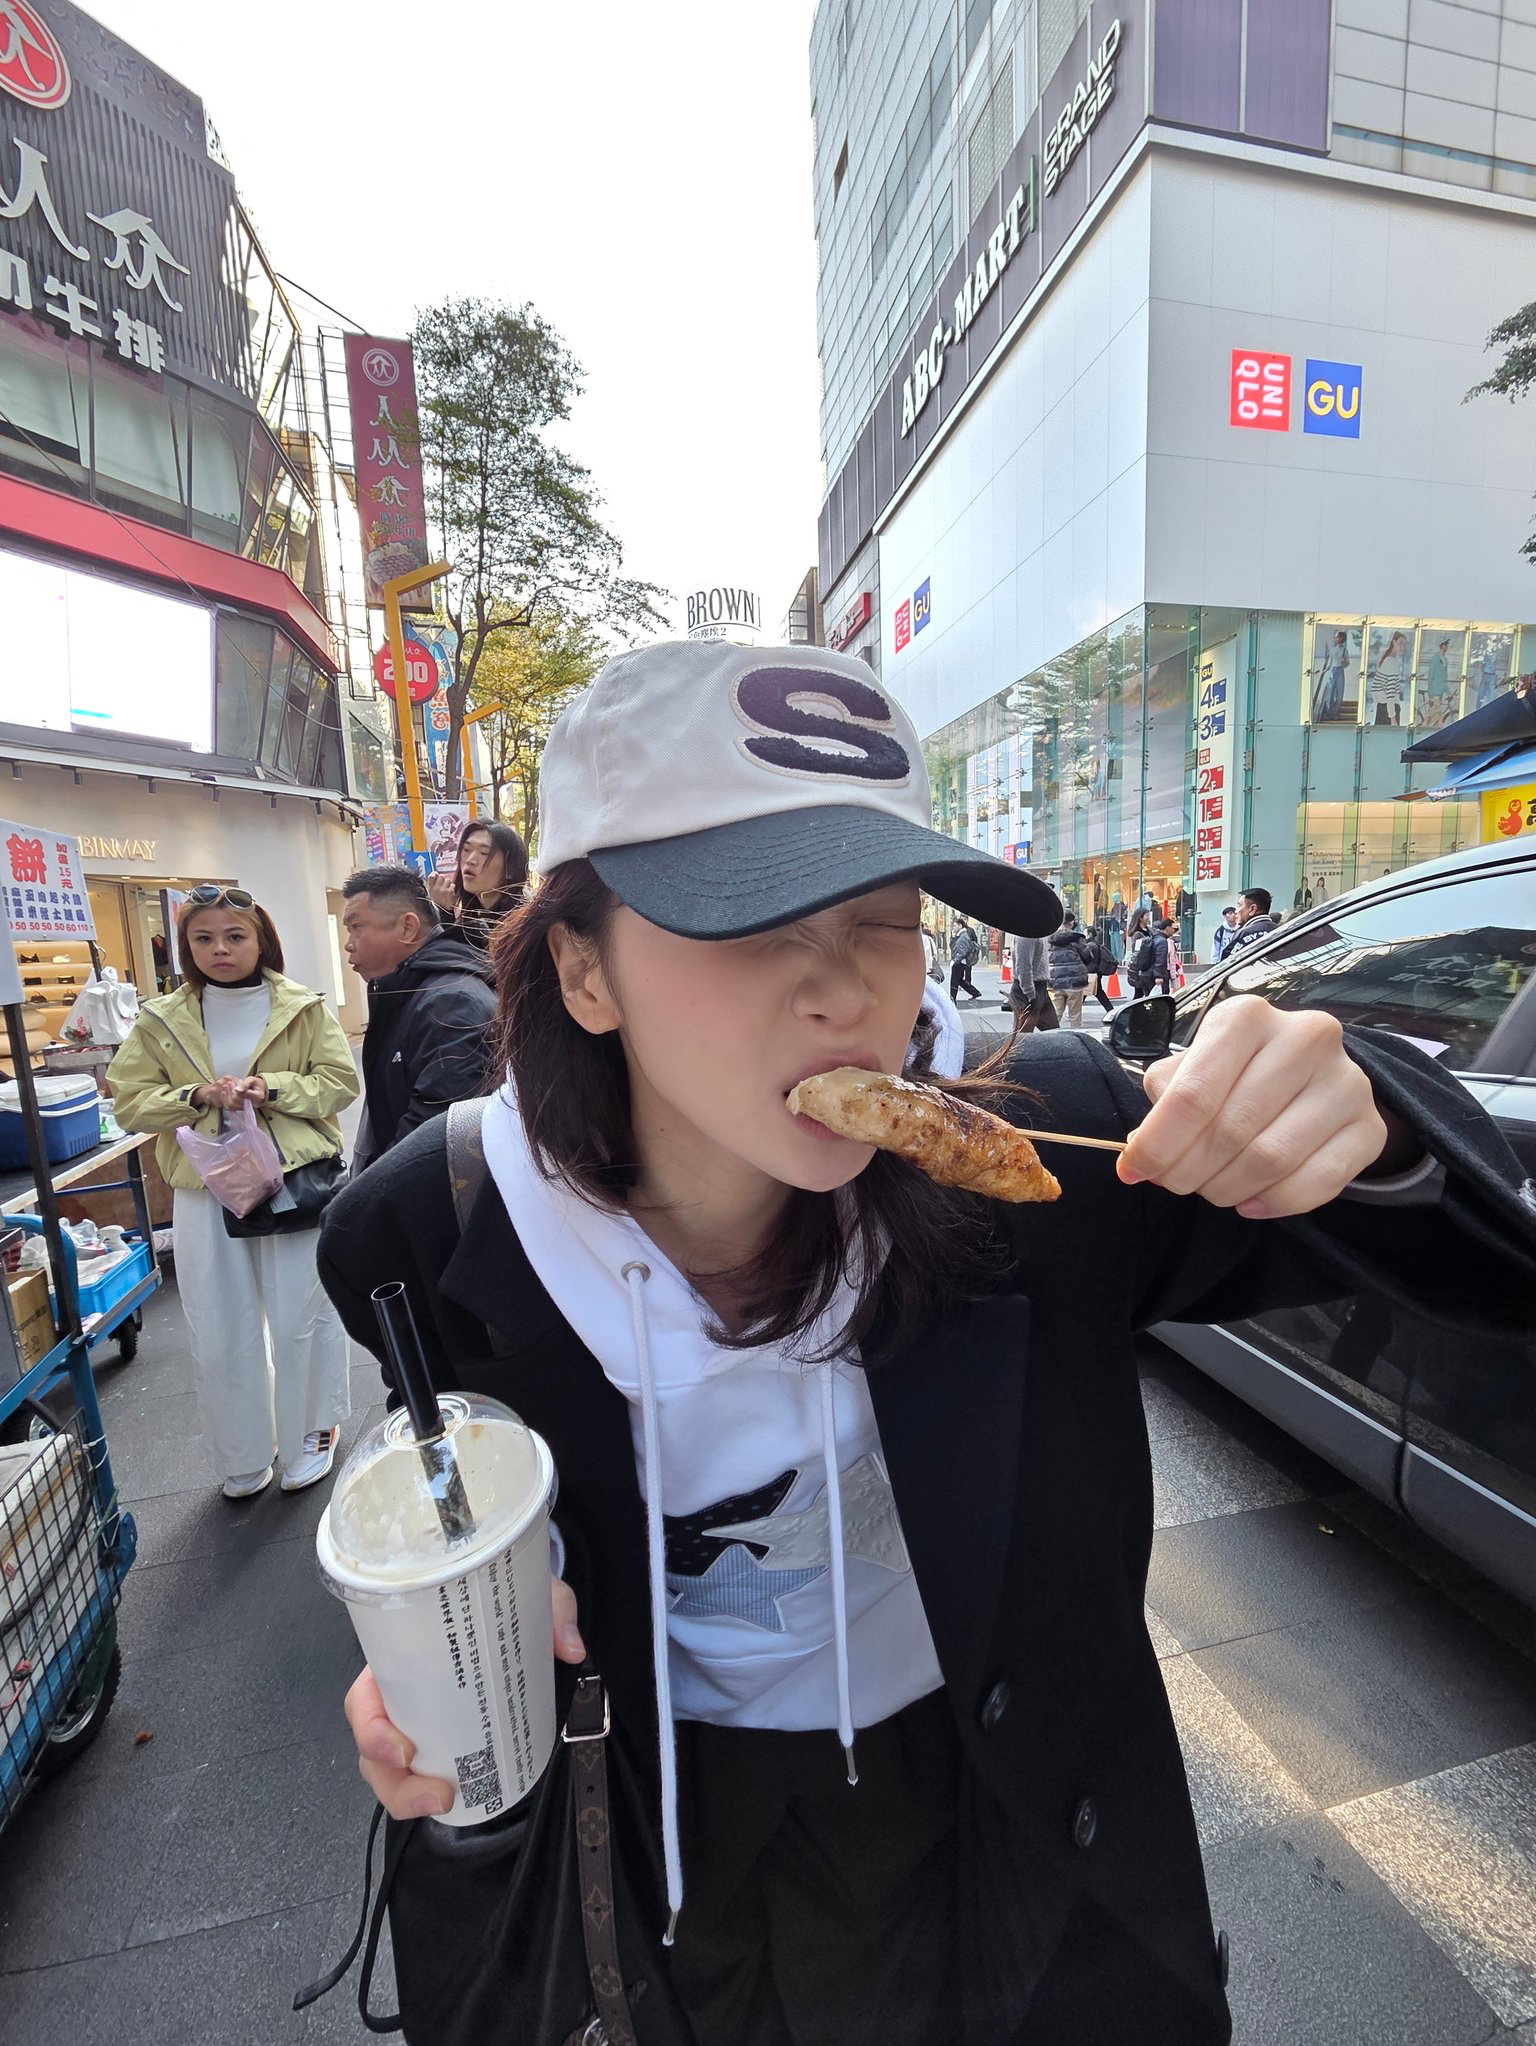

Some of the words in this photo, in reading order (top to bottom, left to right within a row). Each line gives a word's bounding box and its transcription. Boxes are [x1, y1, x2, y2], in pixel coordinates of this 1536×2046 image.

[1045, 18, 1120, 164] GRAND
[1045, 64, 1113, 198] STAGE
[901, 184, 1024, 440] ABC-MART
[1307, 380, 1359, 419] GU
[915, 591, 930, 622] GU
[737, 666, 910, 781] S
[1198, 769, 1217, 793] 2F
[78, 836, 157, 862] BINMAY
[15, 921, 26, 931] 50
[30, 921, 40, 931] 50
[42, 922, 52, 931] 50
[55, 922, 65, 931] 50
[66, 923, 76, 932] 60
[78, 923, 89, 932] 110
